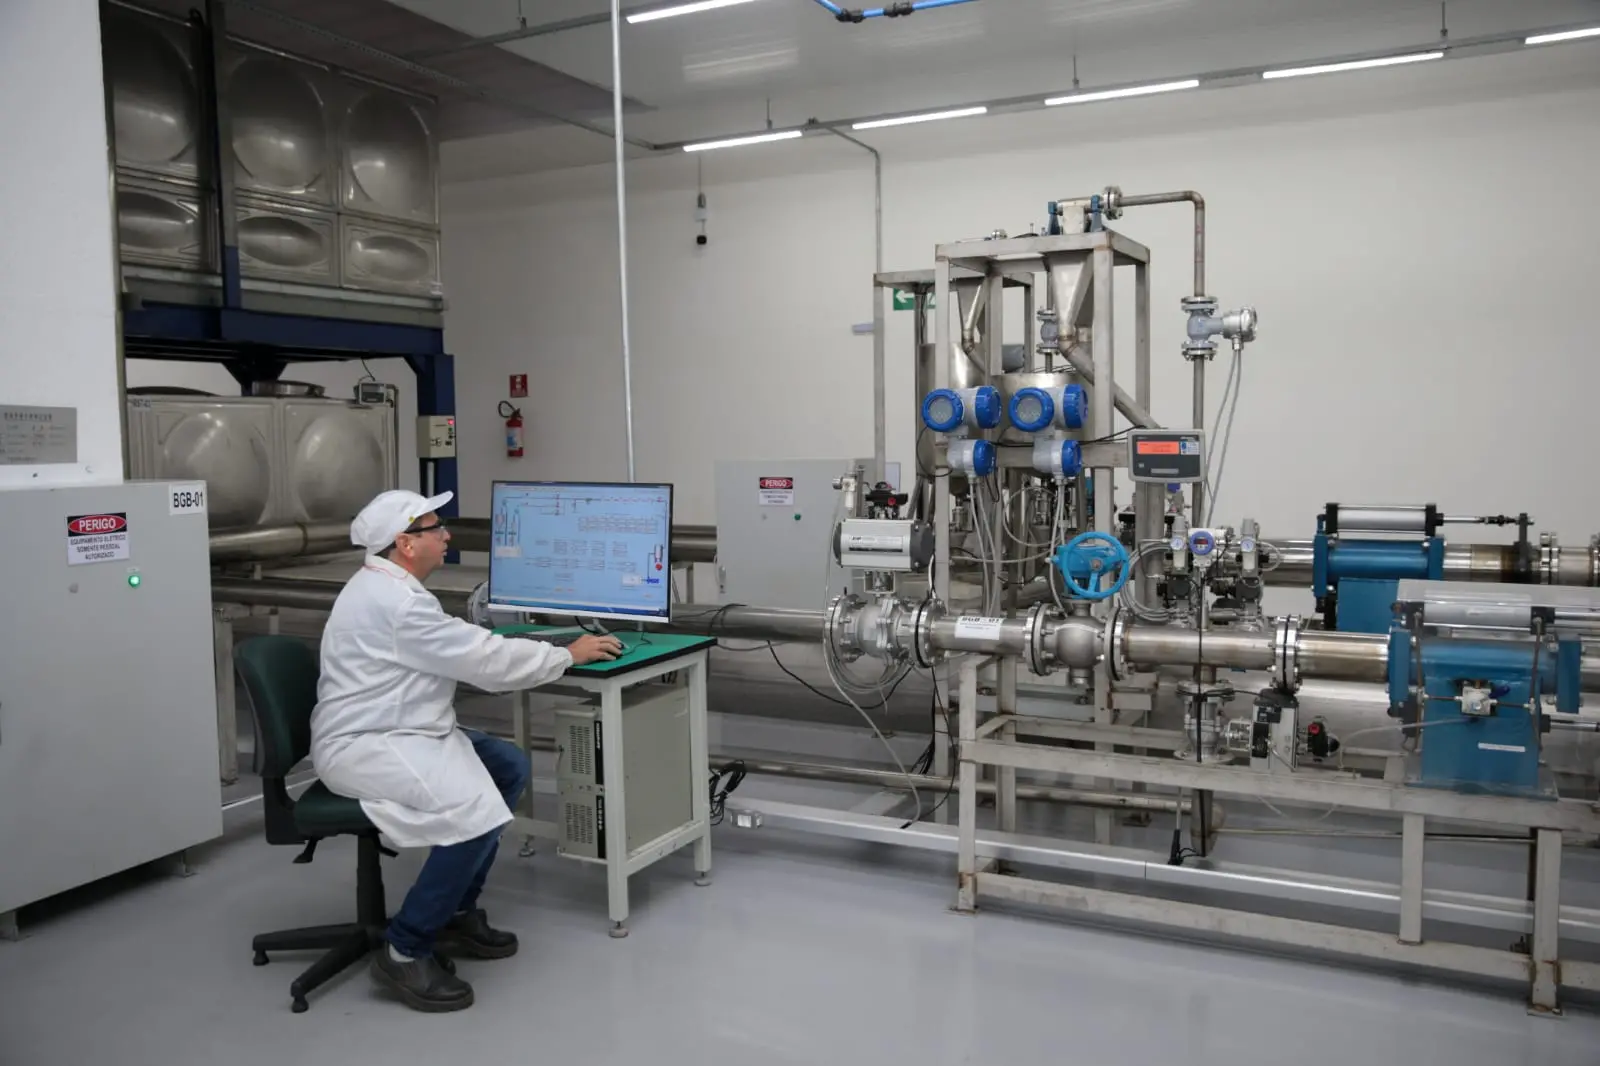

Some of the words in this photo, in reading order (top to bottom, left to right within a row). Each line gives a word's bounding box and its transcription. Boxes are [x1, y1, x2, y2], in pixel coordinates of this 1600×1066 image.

[765, 479, 787, 488] PERIGO
[173, 491, 203, 508] BGB-01
[79, 517, 117, 532] PERIGO
